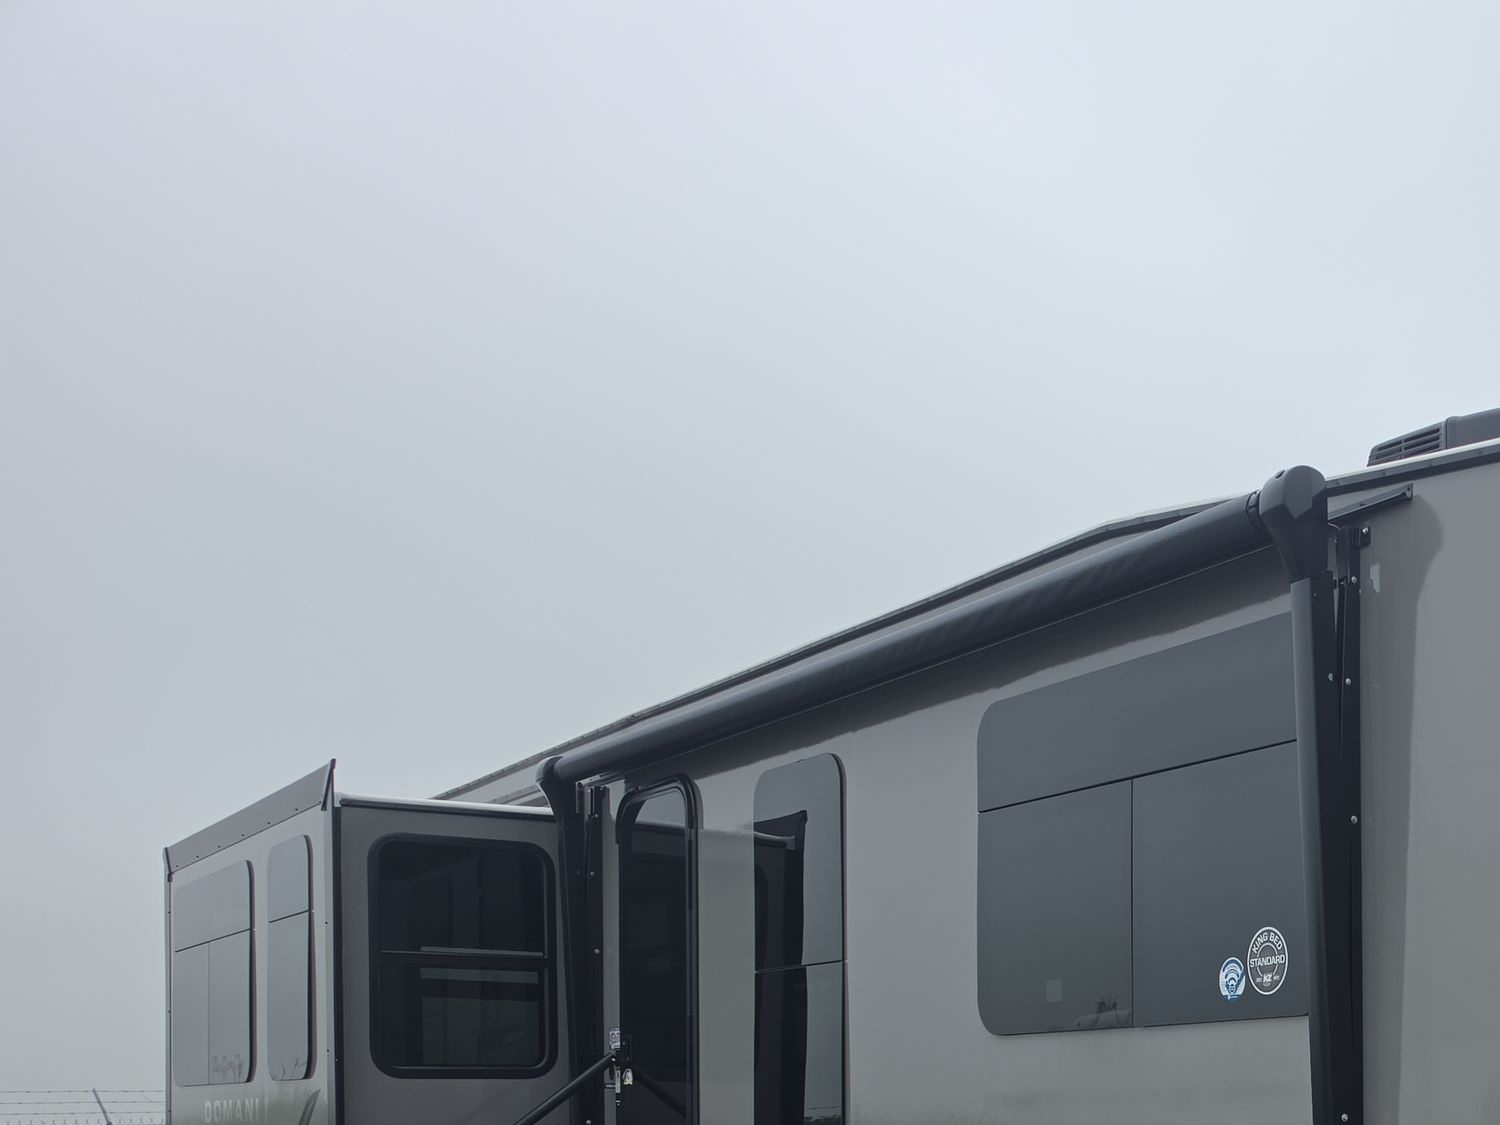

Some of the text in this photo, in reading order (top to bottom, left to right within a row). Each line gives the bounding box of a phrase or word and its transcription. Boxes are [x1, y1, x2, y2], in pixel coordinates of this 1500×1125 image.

[1252, 932, 1282, 953] KING BED
[1250, 955, 1285, 968] STANDARD
[204, 1098, 259, 1123] DOMANI
